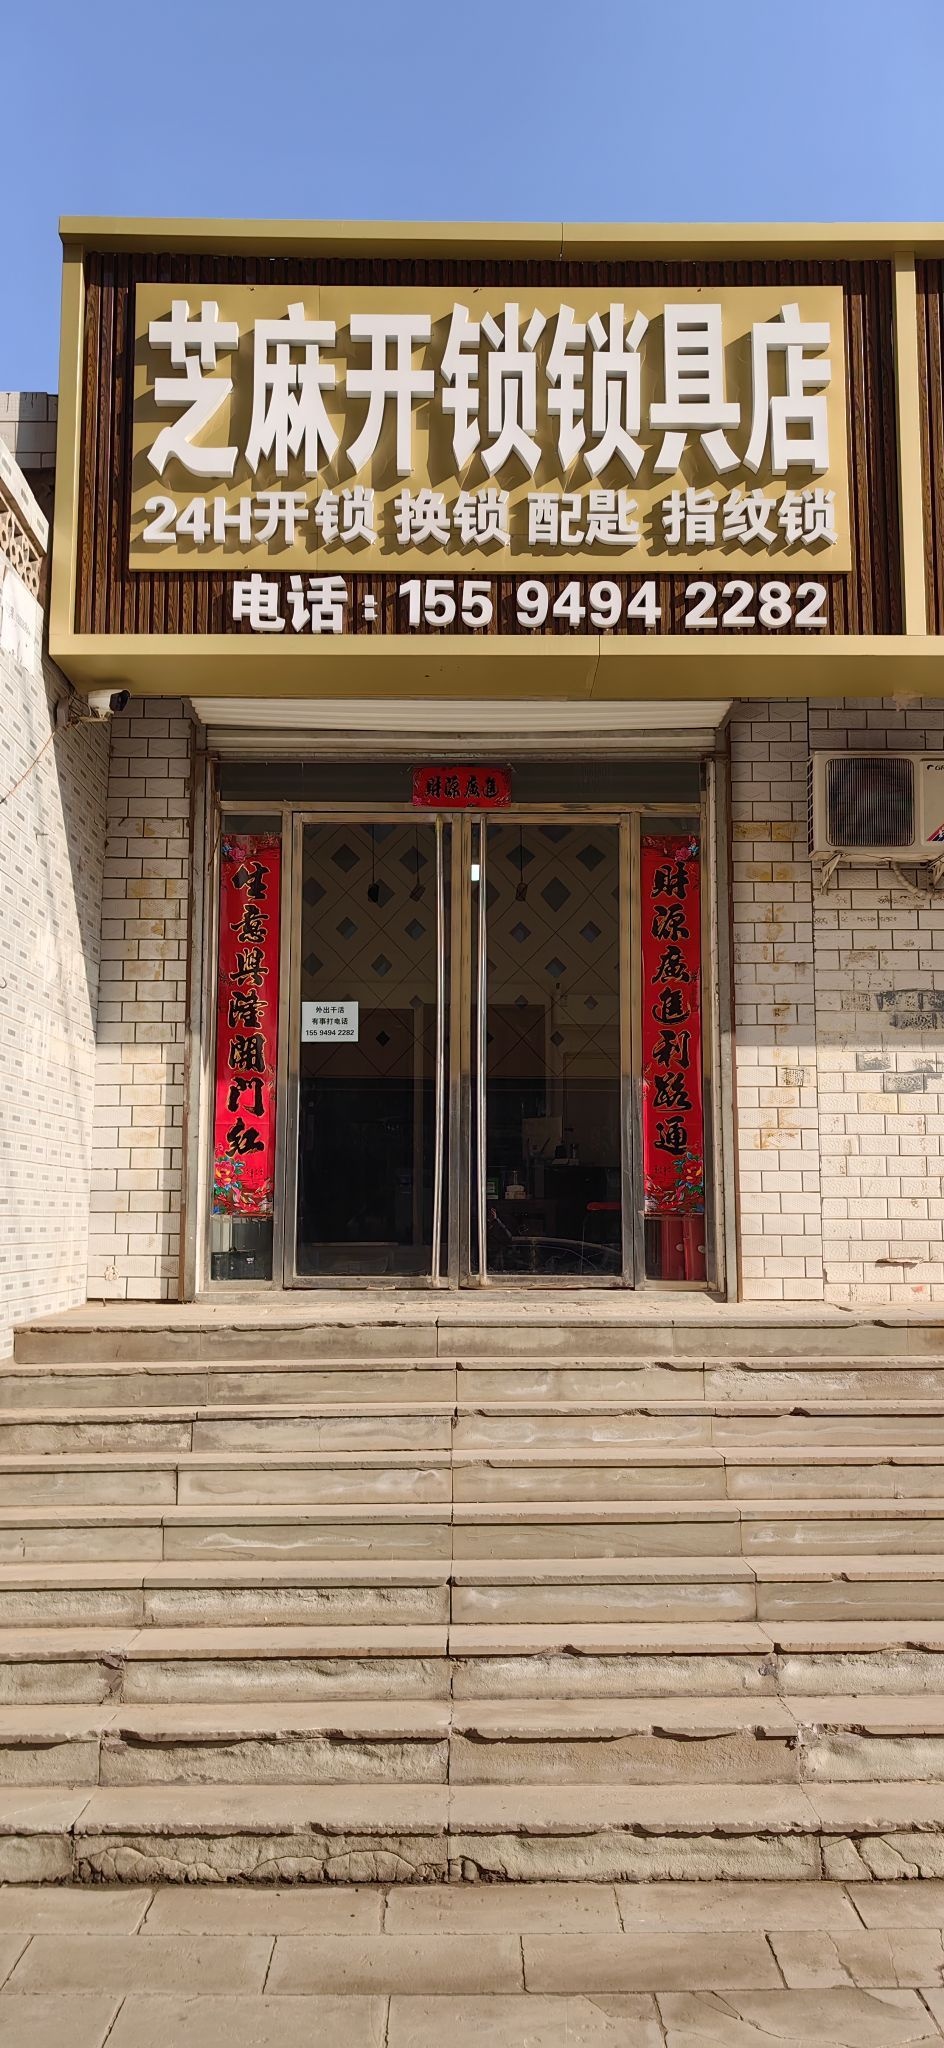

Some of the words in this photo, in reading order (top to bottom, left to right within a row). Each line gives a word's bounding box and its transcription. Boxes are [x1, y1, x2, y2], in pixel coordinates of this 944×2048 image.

[147, 299, 833, 478] 芝麻开锁锁具店
[142, 485, 377, 546] 24H开锁
[394, 487, 510, 546] 换锁
[526, 488, 642, 547] 配匙
[661, 487, 838, 546] 指纹锁
[398, 579, 494, 628] 155
[516, 579, 662, 629] 9494
[684, 580, 828, 630] 2282
[311, 1017, 349, 1026] 有事打电话
[315, 1006, 345, 1014] 外出干活
